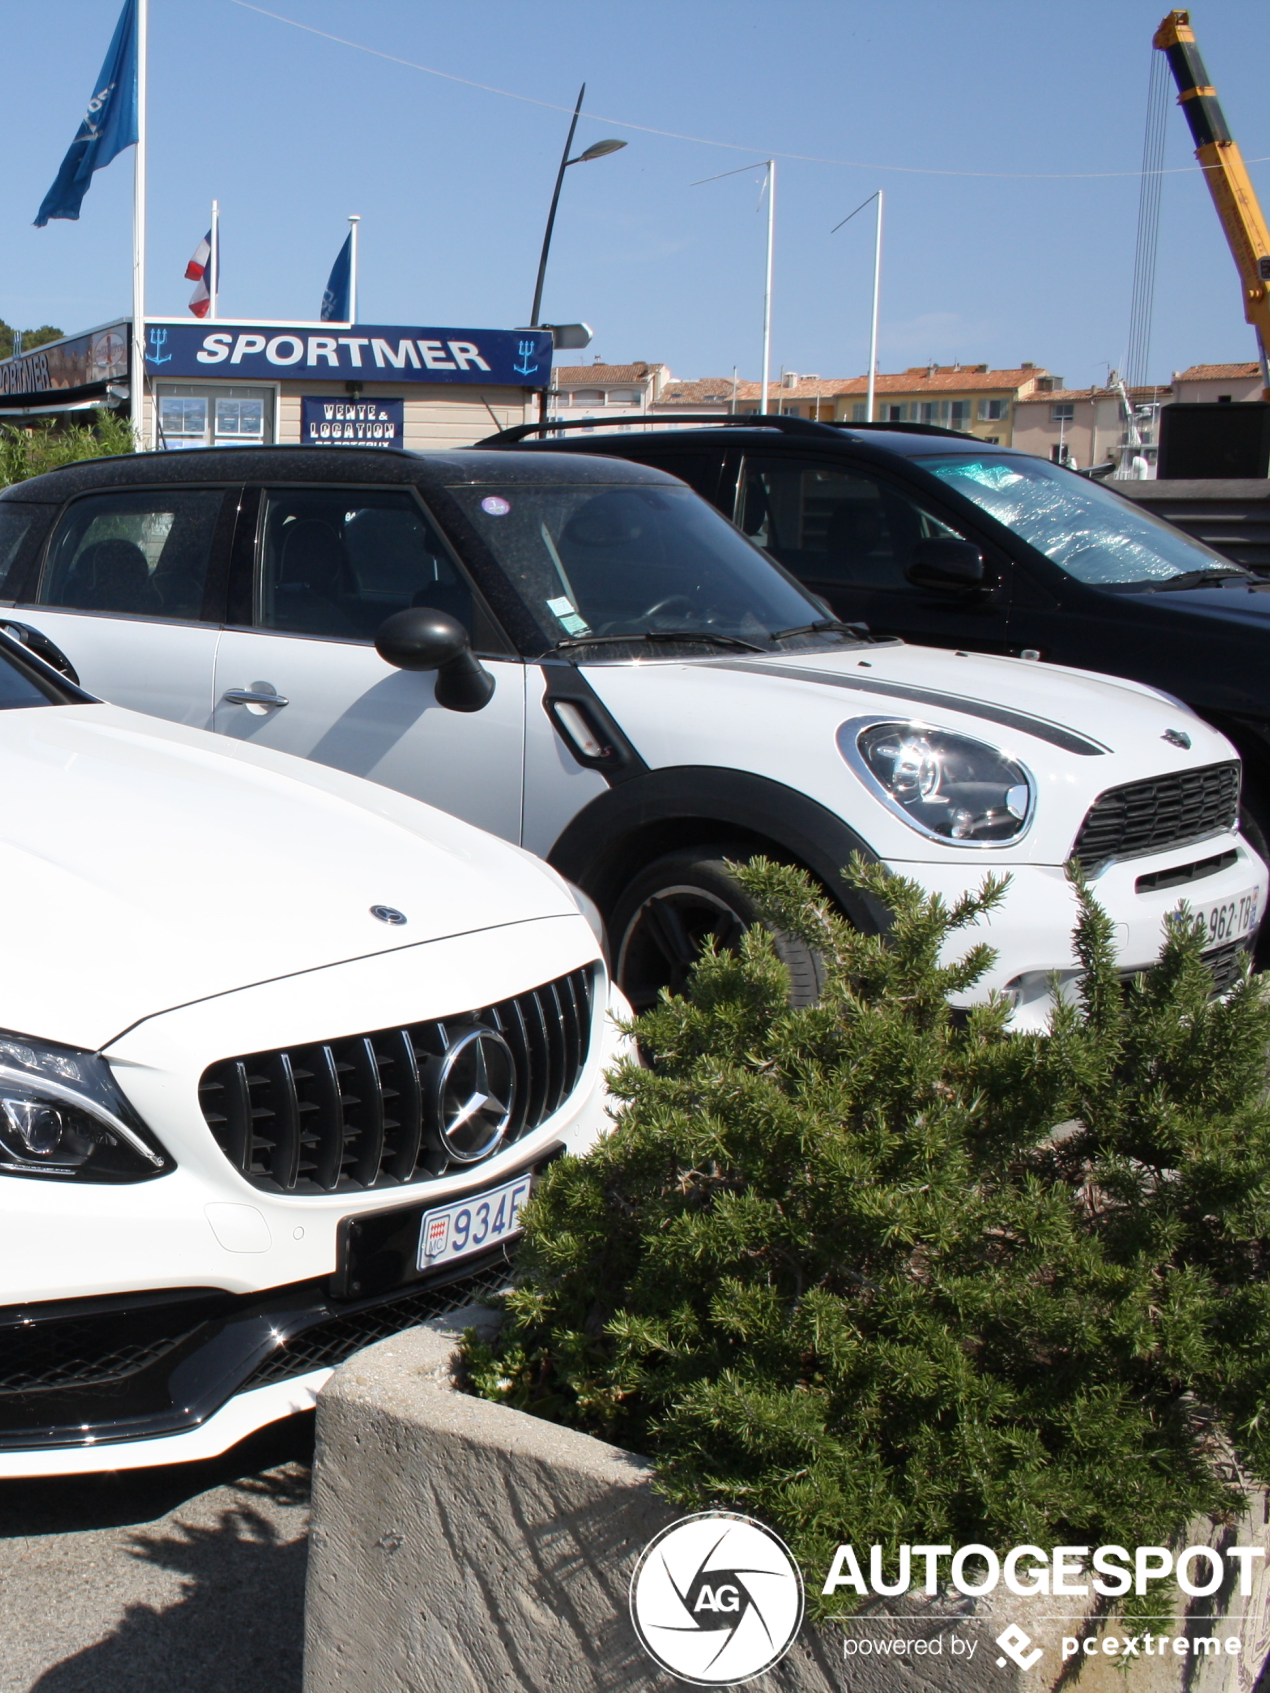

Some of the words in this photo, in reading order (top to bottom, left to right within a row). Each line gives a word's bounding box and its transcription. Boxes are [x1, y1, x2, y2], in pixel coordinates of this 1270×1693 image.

[196, 333, 491, 372] SPORTMER
[323, 404, 376, 420] VENTE
[378, 411, 388, 420] &
[310, 422, 395, 438] LOCATION
[451, 1185, 526, 1251] 934F
[429, 1237, 443, 1250] MC
